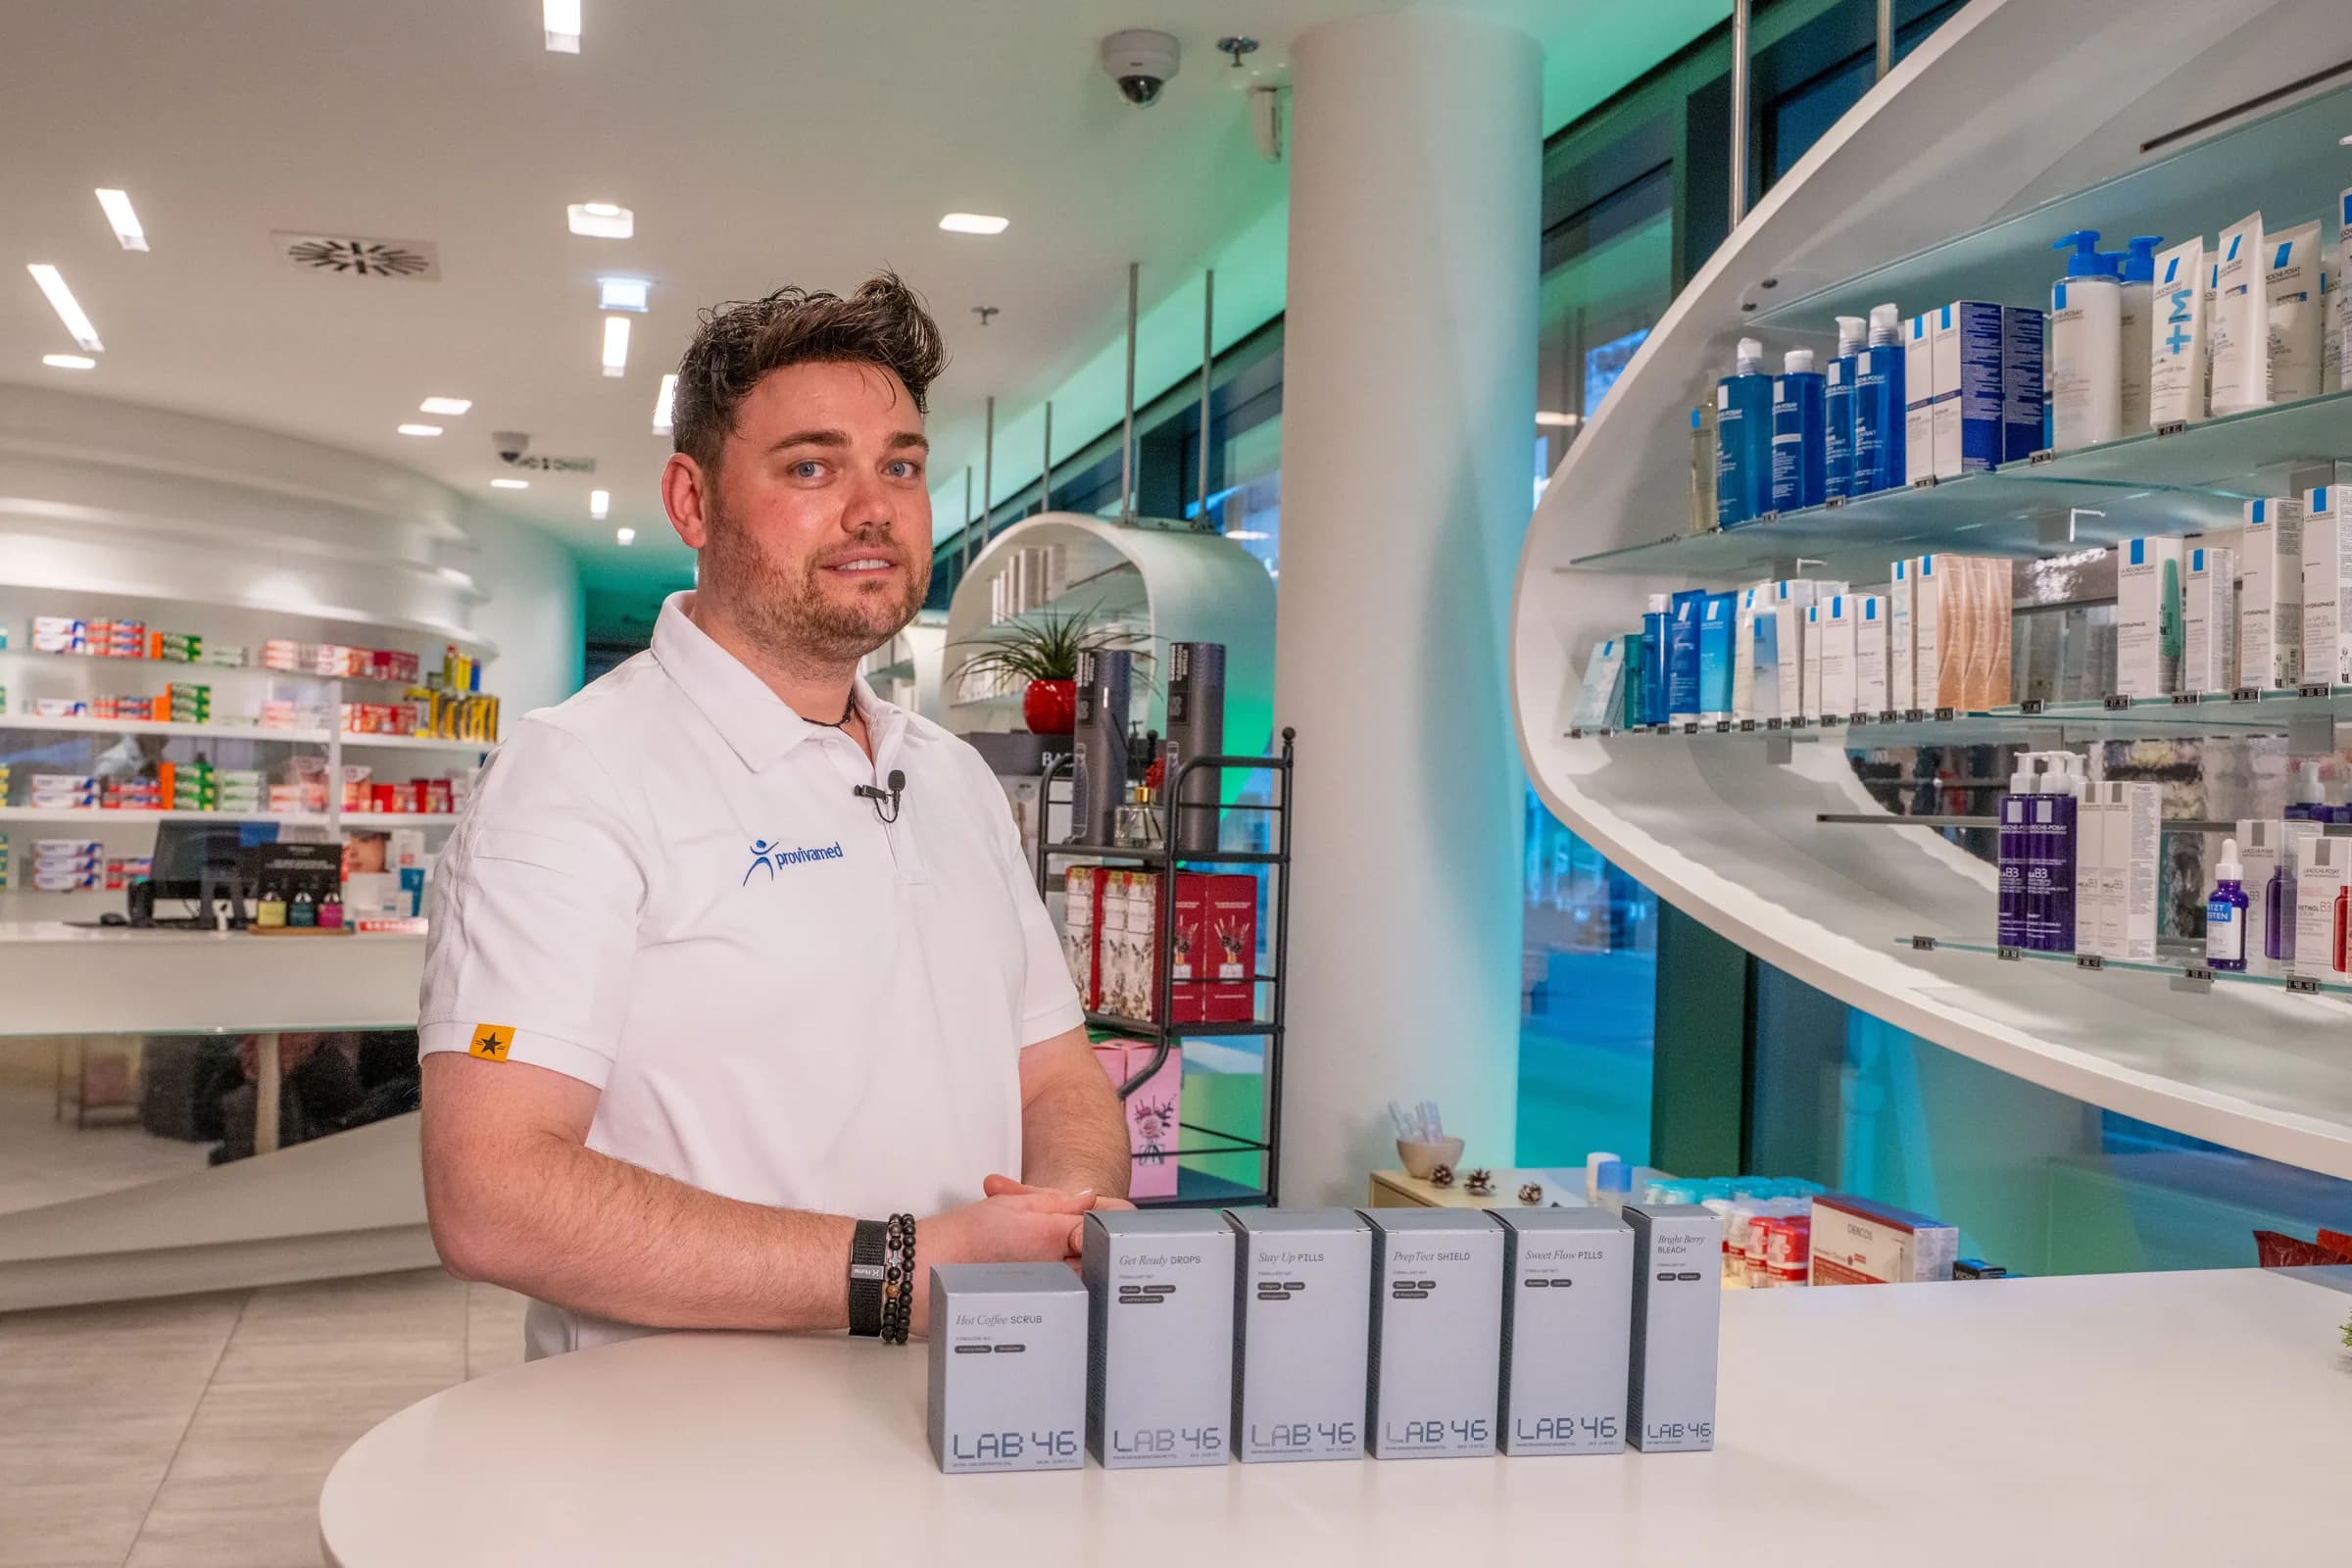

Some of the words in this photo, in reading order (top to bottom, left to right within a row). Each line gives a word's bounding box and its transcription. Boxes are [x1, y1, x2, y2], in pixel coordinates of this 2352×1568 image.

[774, 841, 844, 870] provivamed
[1657, 1234, 1683, 1246] Bright
[1683, 1234, 1707, 1246] Berry
[1437, 1252, 1471, 1262] SHIELD
[1525, 1250, 1552, 1261] Sweet
[1553, 1250, 1577, 1261] Flow
[1577, 1250, 1603, 1260] PILLS
[1657, 1246, 1687, 1254] BLEACH
[1119, 1254, 1137, 1265] Get
[1139, 1253, 1168, 1267] Ready
[1170, 1255, 1201, 1265] DROPS
[1257, 1251, 1279, 1264] Stay
[1281, 1251, 1297, 1265] Up
[1297, 1253, 1325, 1262] PILLS
[956, 1314, 975, 1326] Hot
[977, 1314, 1008, 1328] Coffee
[1010, 1315, 1043, 1325] SCRUB
[1250, 1423, 1311, 1446] LAB
[1317, 1422, 1356, 1445] 46
[1386, 1421, 1445, 1443] LAB
[1450, 1419, 1489, 1442] 46
[1517, 1417, 1574, 1440] LAB
[1581, 1416, 1617, 1439] 46
[1646, 1423, 1685, 1439] LAB
[1688, 1422, 1711, 1438] 46
[954, 1432, 1023, 1459] LAB
[1031, 1431, 1077, 1456] 46
[1113, 1429, 1175, 1452] LAB
[1182, 1427, 1221, 1450] 46
